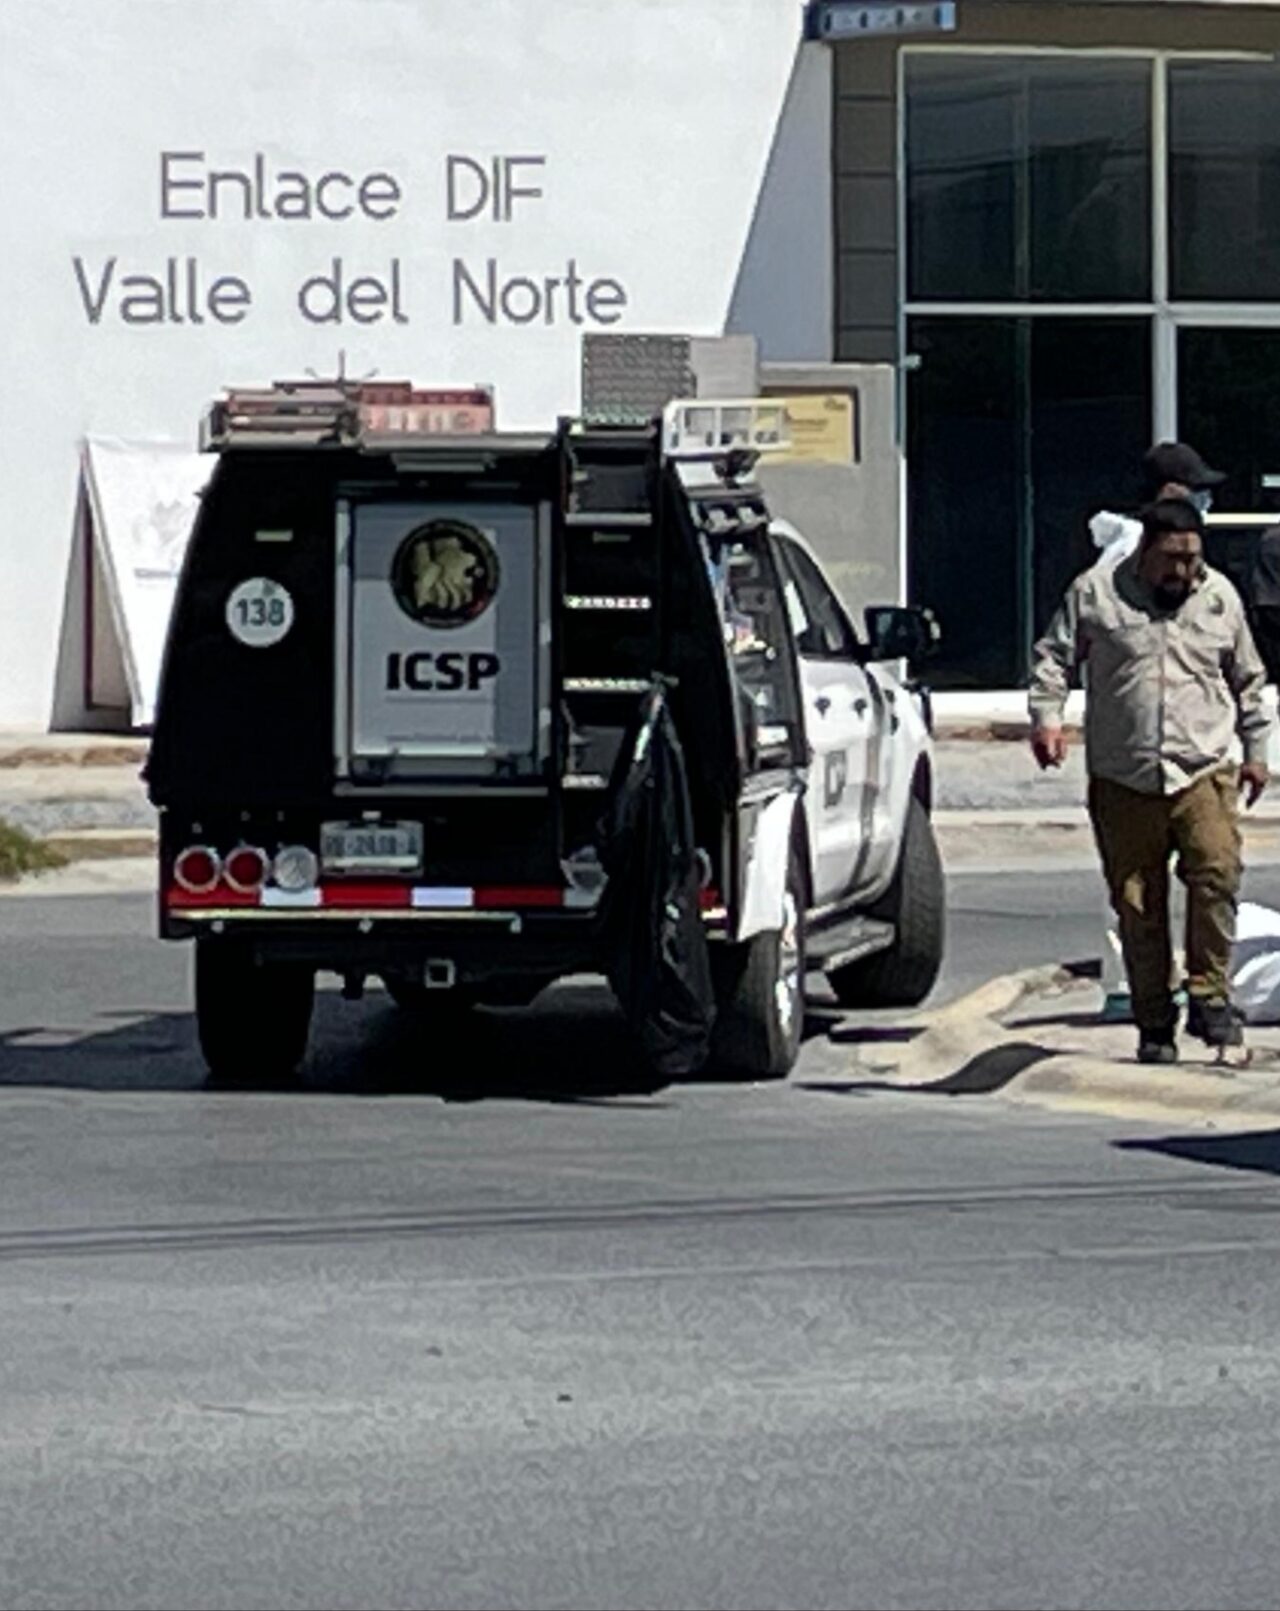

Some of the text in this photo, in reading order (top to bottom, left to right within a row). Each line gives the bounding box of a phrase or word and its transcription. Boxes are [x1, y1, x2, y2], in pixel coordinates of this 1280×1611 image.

[160, 151, 546, 222] Enlace DIF
[73, 257, 627, 325] Valle del Norte
[236, 597, 285, 627] 138
[386, 652, 502, 692] ICSP
